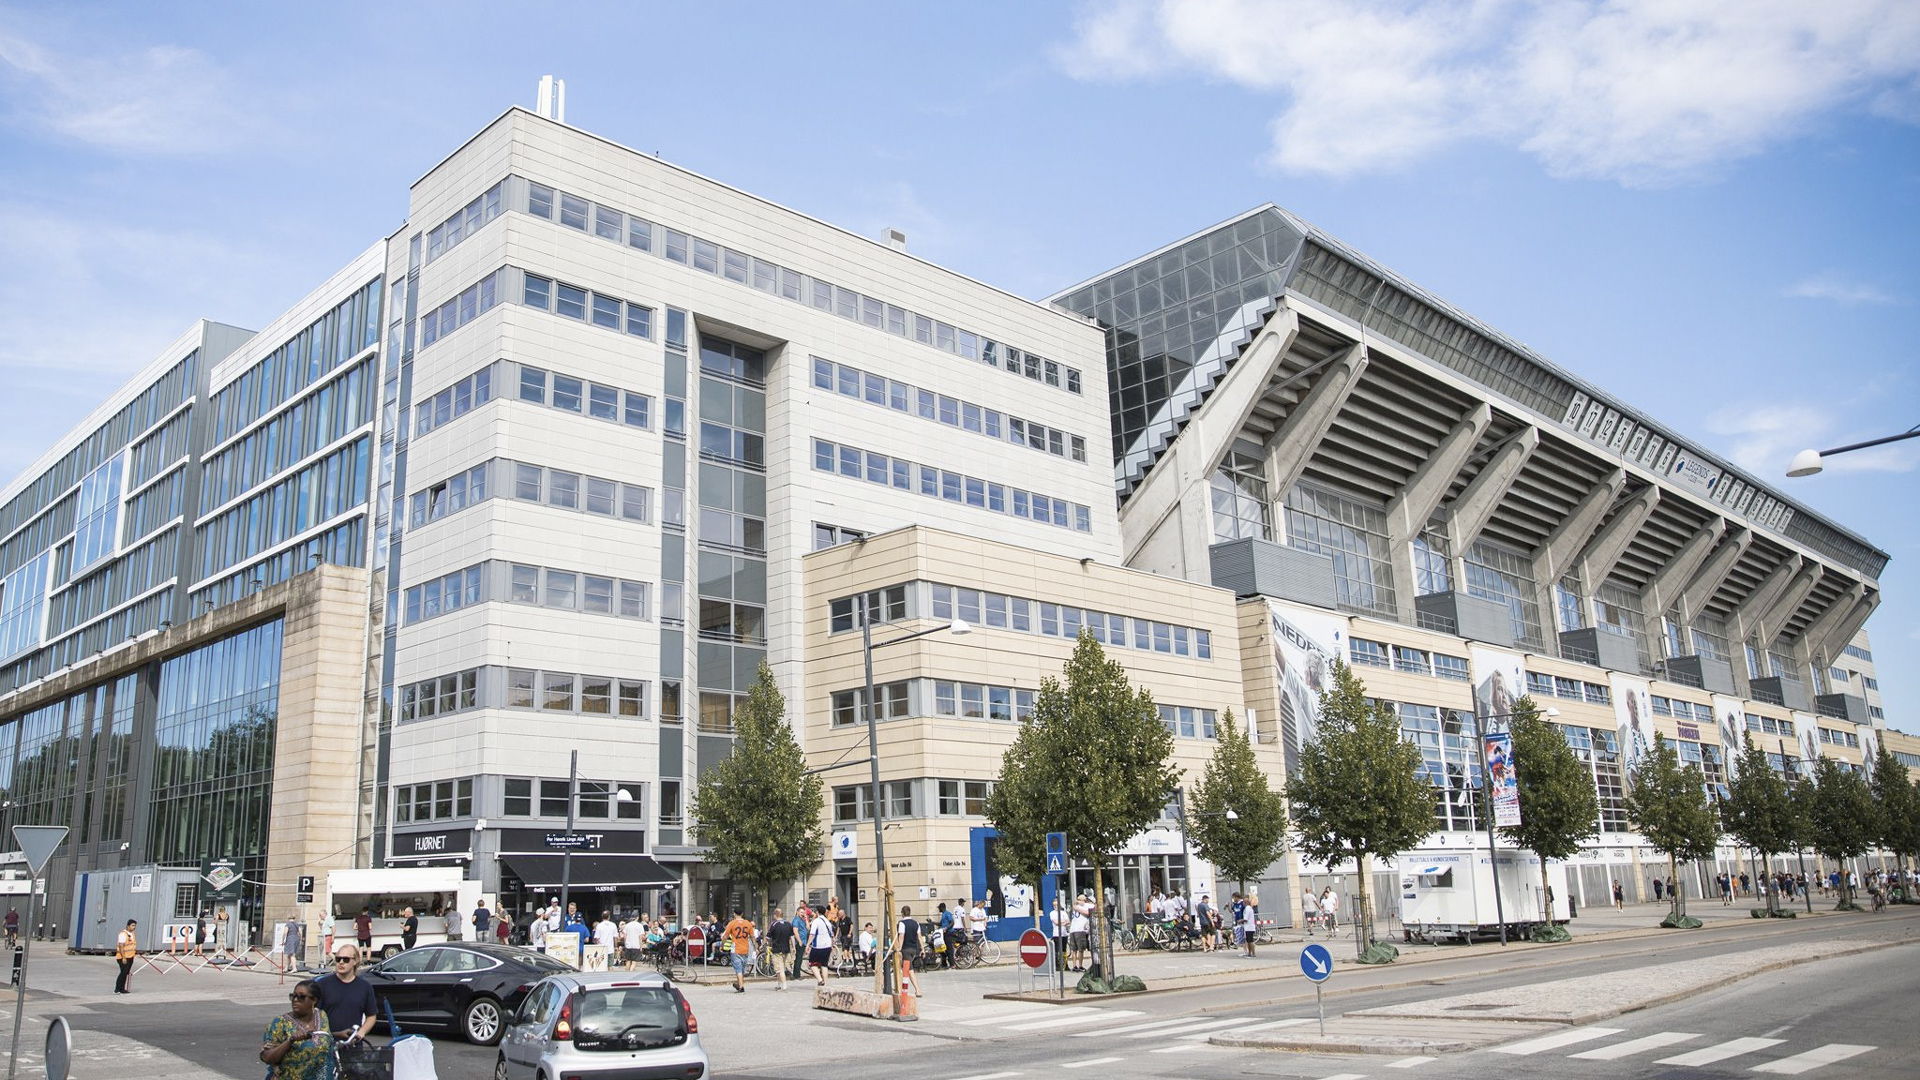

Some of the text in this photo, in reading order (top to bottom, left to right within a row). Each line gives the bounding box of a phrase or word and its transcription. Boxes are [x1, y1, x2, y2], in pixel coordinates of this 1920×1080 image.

[1569, 402, 1580, 419] 10
[1586, 411, 1598, 428] 17
[1602, 419, 1613, 436] 12
[1618, 427, 1627, 443] 5
[1632, 436, 1643, 450] 10
[1685, 460, 1710, 479] LEGENDS
[414, 835, 447, 851] HJØRNET
[302, 878, 311, 891] P
[735, 926, 748, 939] 25
